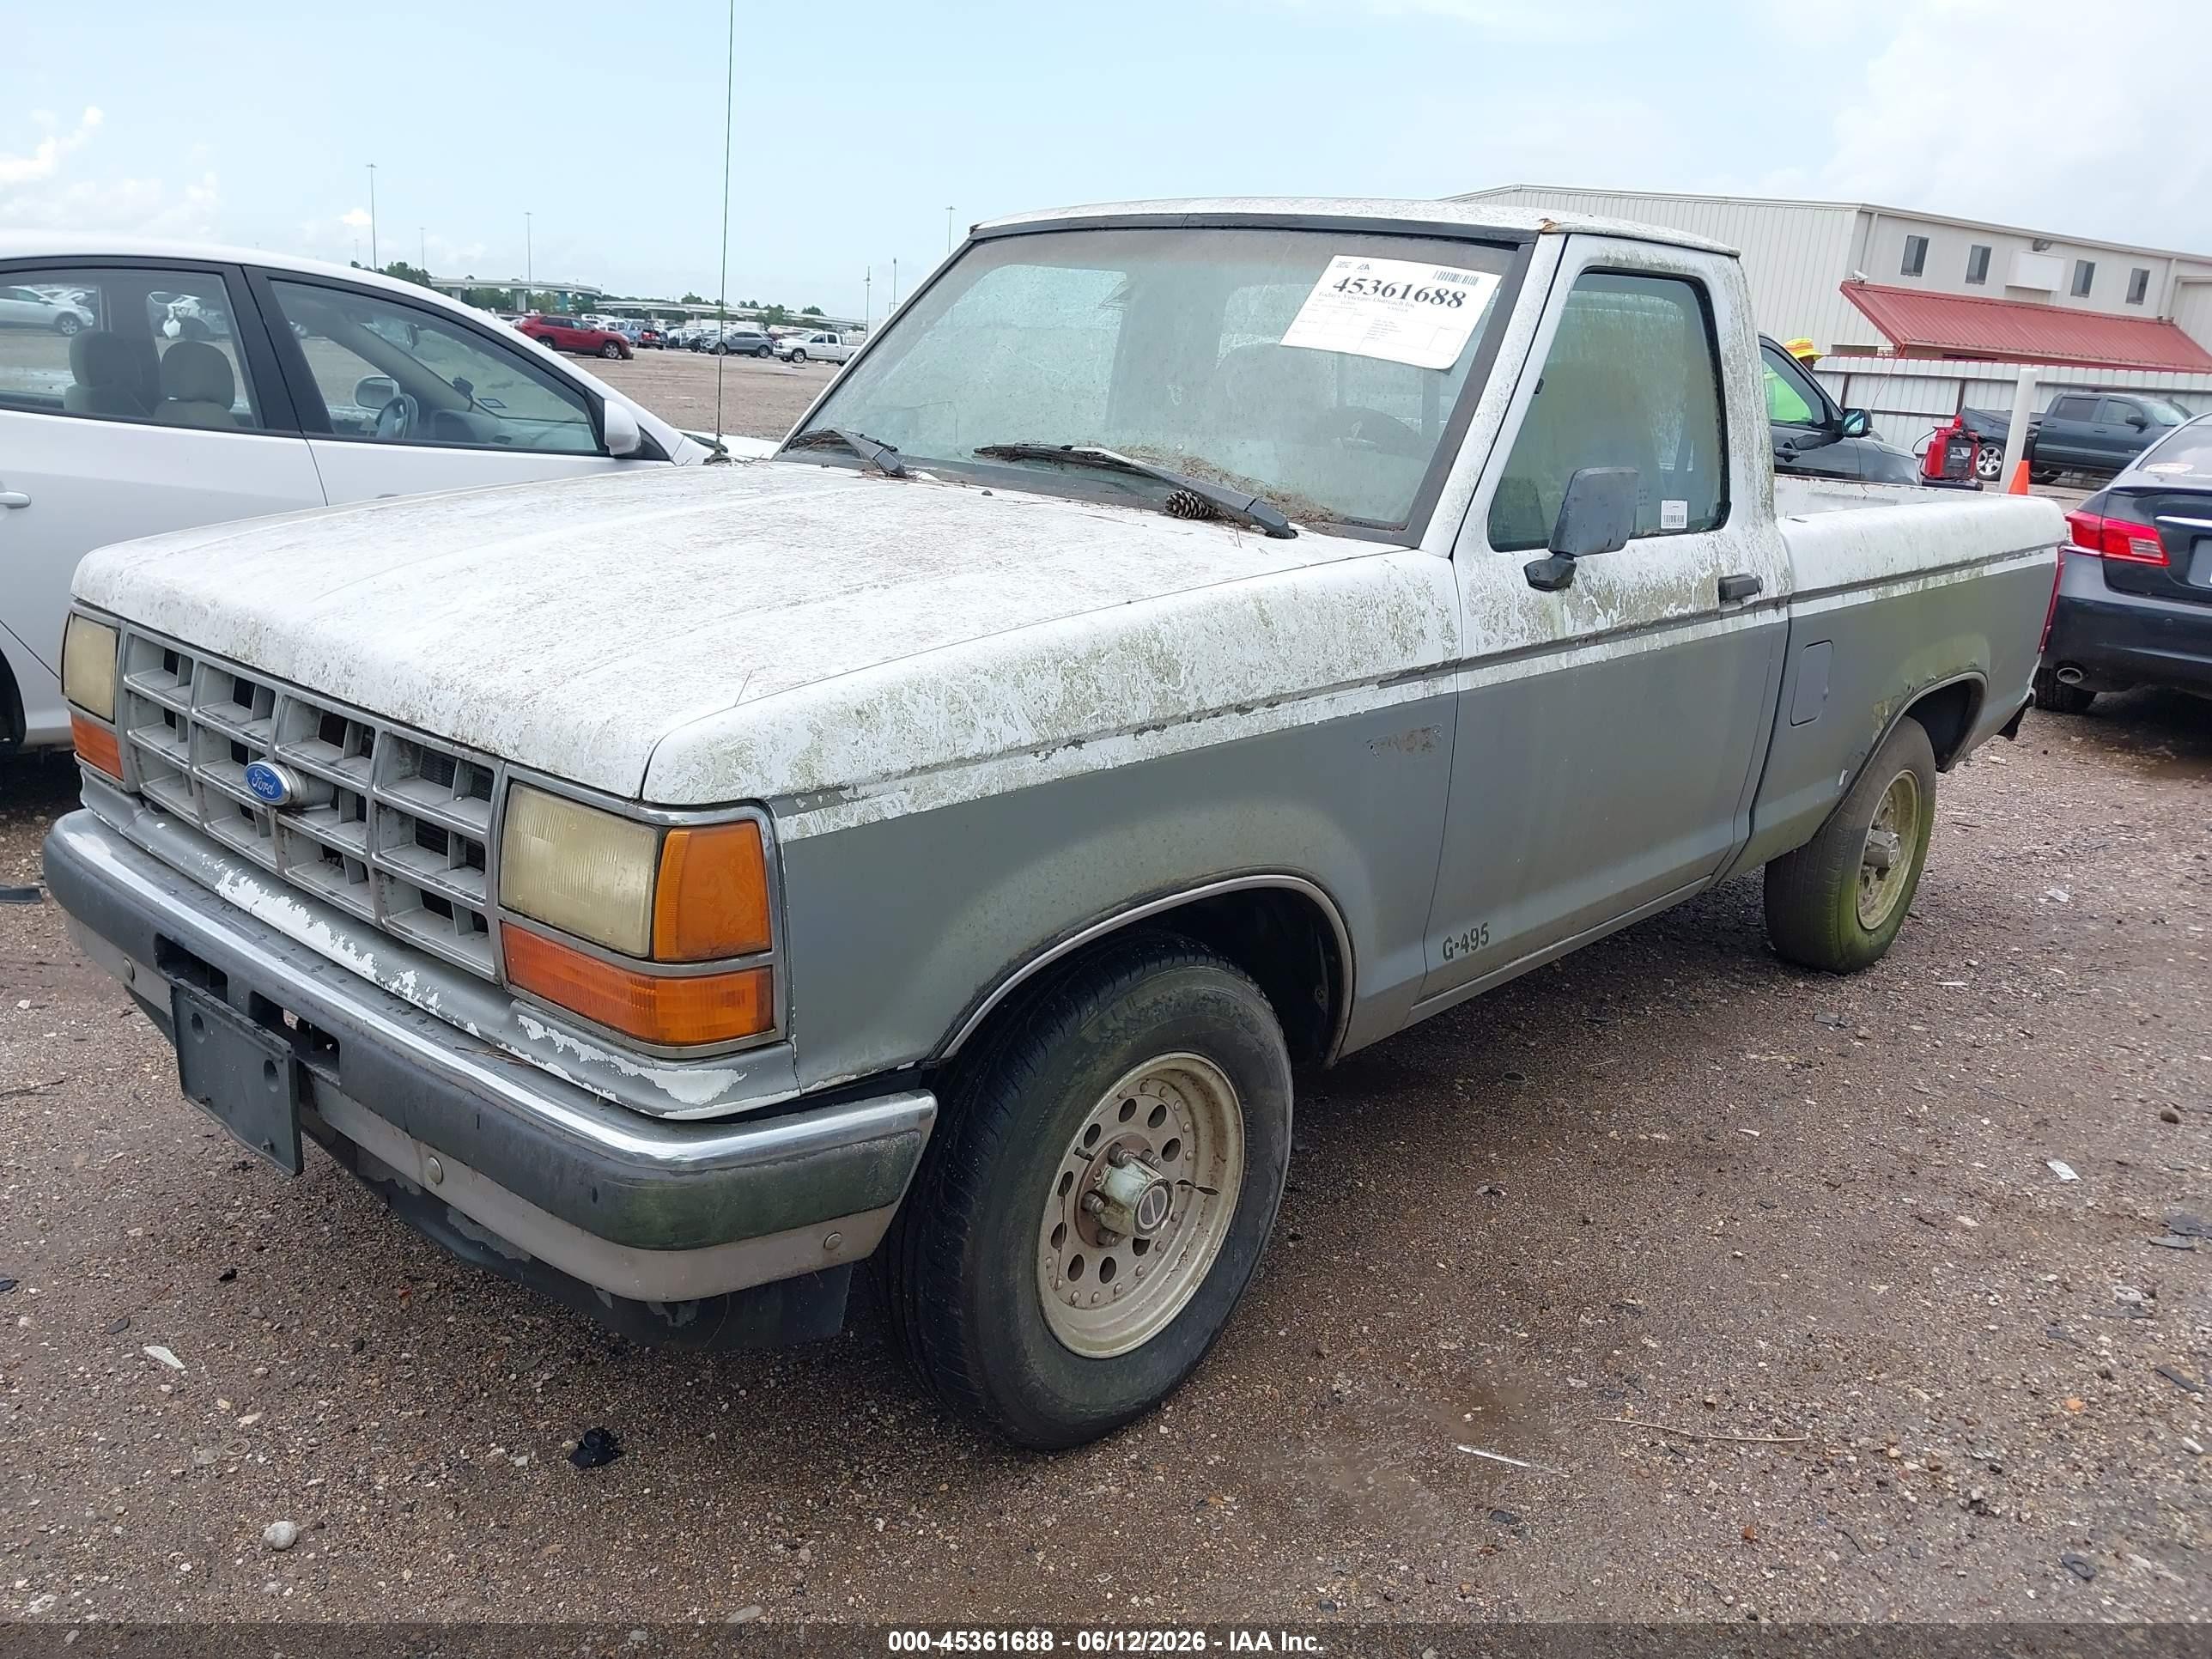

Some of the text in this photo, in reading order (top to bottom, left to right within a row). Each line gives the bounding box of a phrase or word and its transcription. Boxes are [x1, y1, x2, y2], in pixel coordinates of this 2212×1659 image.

[1333, 276, 1467, 308] 45361688
[252, 769, 276, 796] Ford
[1442, 921, 1490, 962] G-495
